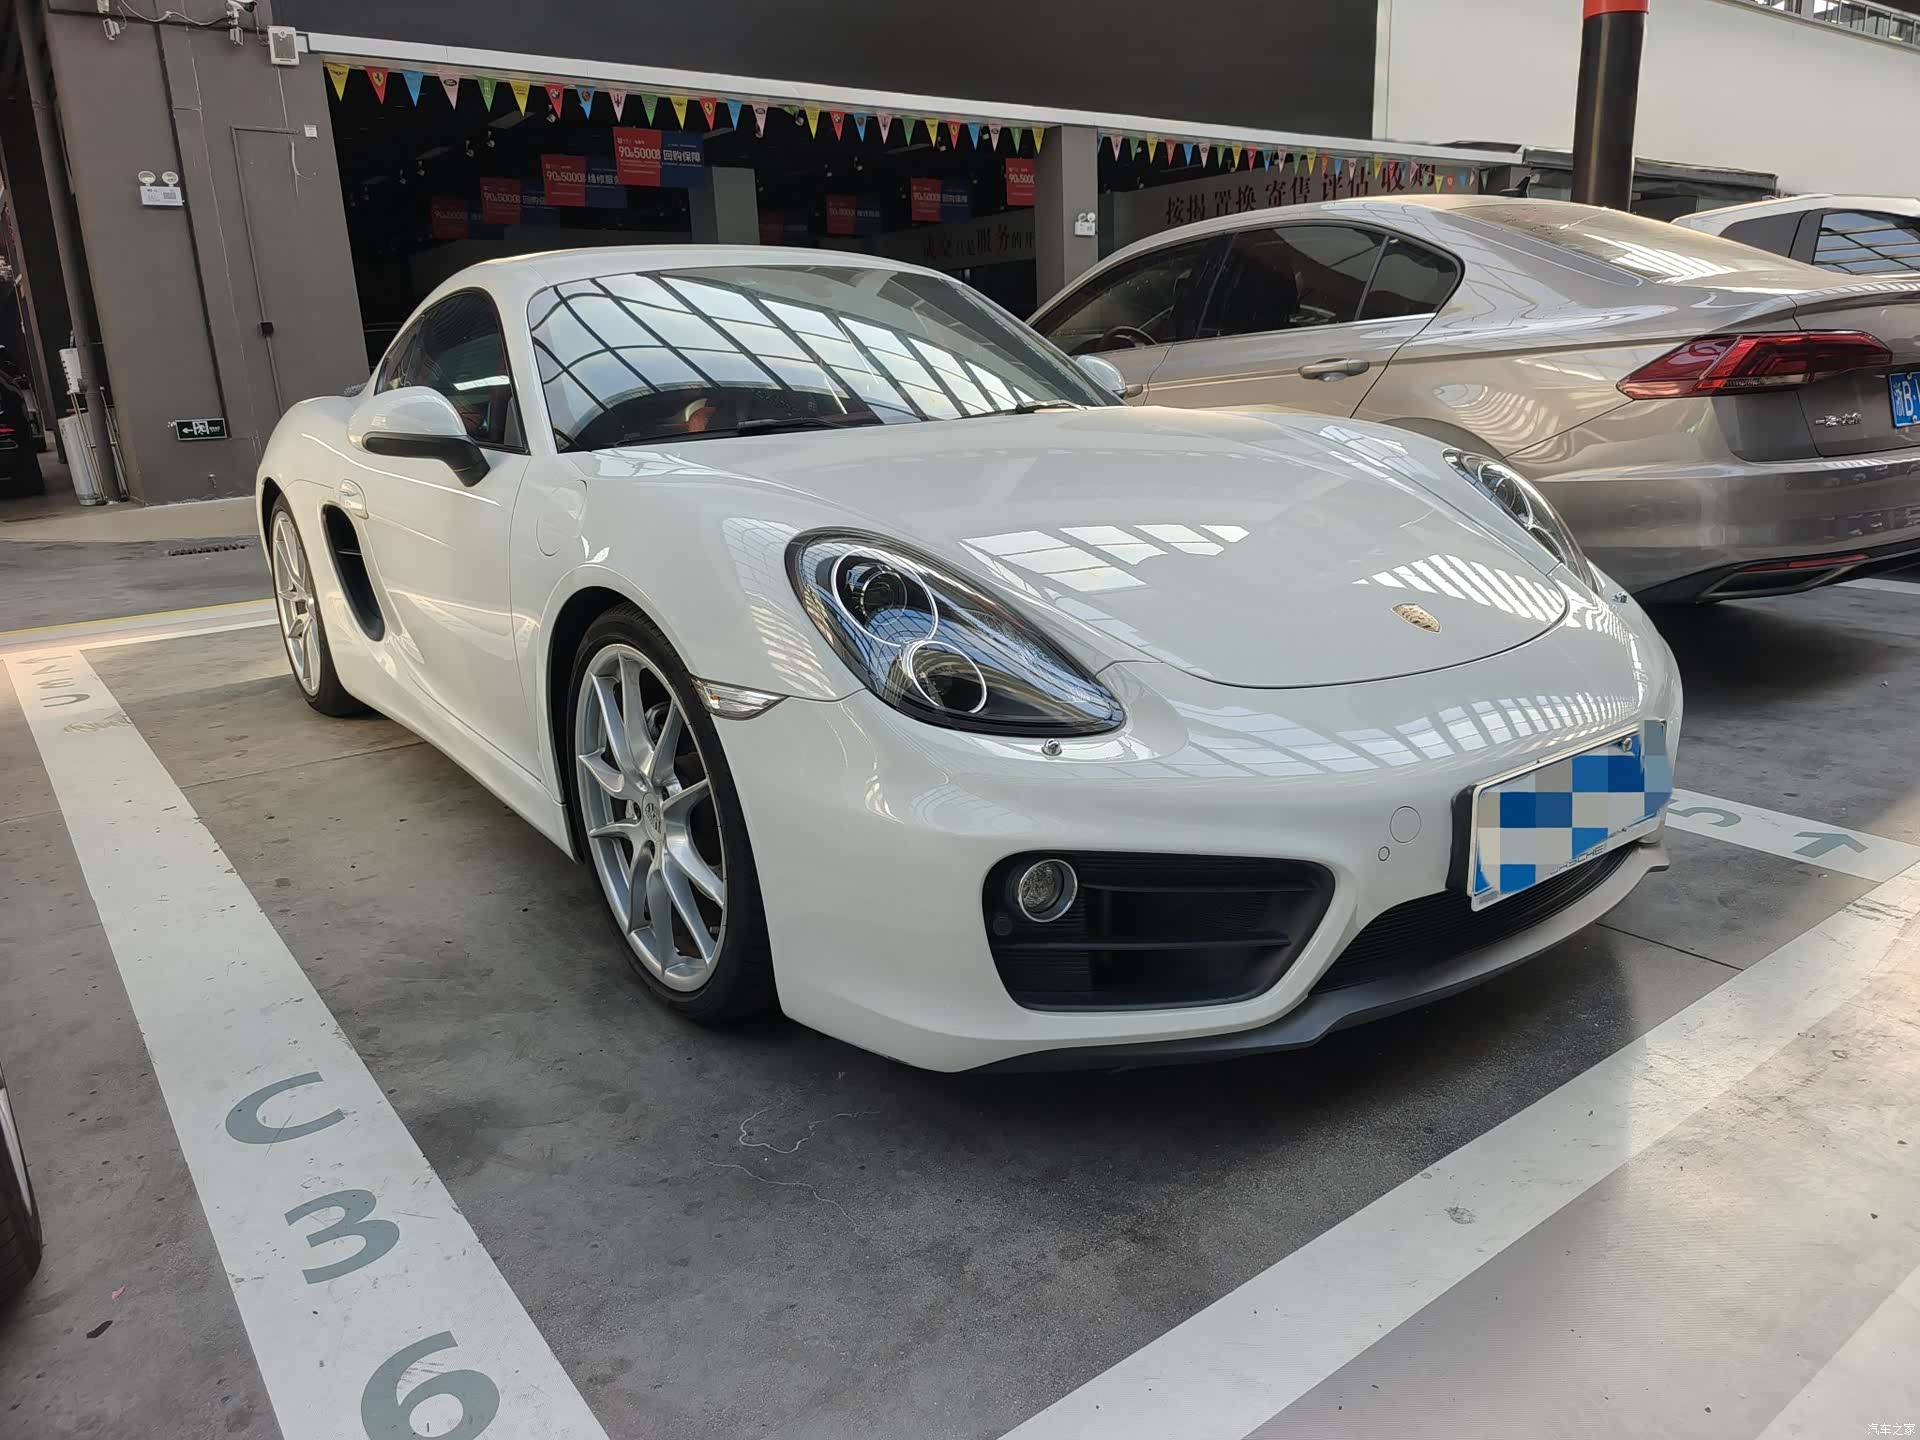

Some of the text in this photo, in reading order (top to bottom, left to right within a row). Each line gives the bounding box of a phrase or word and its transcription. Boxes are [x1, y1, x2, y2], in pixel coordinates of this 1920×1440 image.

[663, 149, 701, 163] 回购保障
[1214, 185, 1257, 215] 置换
[1265, 177, 1311, 208] 寄售
[1321, 166, 1370, 201] 评估
[1380, 162, 1436, 193] 收购
